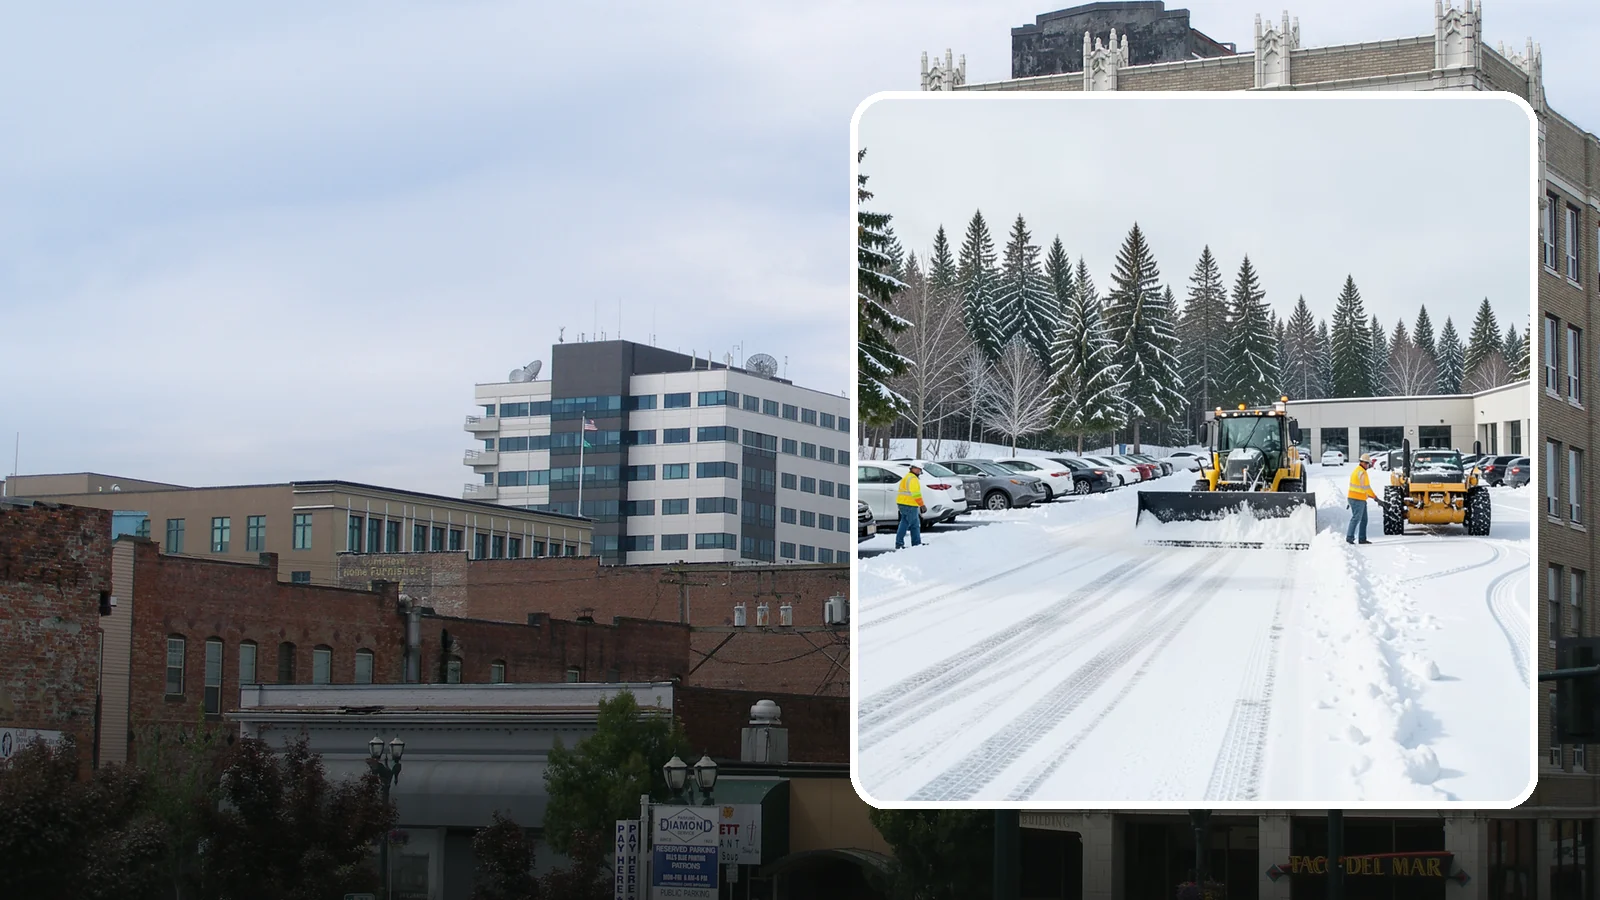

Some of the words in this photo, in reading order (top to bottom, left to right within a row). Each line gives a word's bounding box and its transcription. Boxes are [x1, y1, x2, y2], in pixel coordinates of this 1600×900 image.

[343, 568, 367, 577] Home
[370, 566, 427, 577] Furnishers
[660, 818, 713, 832] DIAMOND
[1021, 815, 1070, 828] BUILDING
[617, 825, 625, 852] PAY
[628, 824, 636, 852] PAY
[656, 845, 688, 853] RESERVED
[689, 846, 716, 854] PARKING
[722, 851, 739, 862] Soup
[671, 862, 701, 870] PATRONS
[1346, 857, 1385, 876] DEL
[1392, 857, 1443, 876] MAR
[616, 856, 625, 893] HERE
[627, 855, 636, 893] HERE
[660, 888, 682, 897] PUBLIC
[683, 889, 710, 898] PARKING
